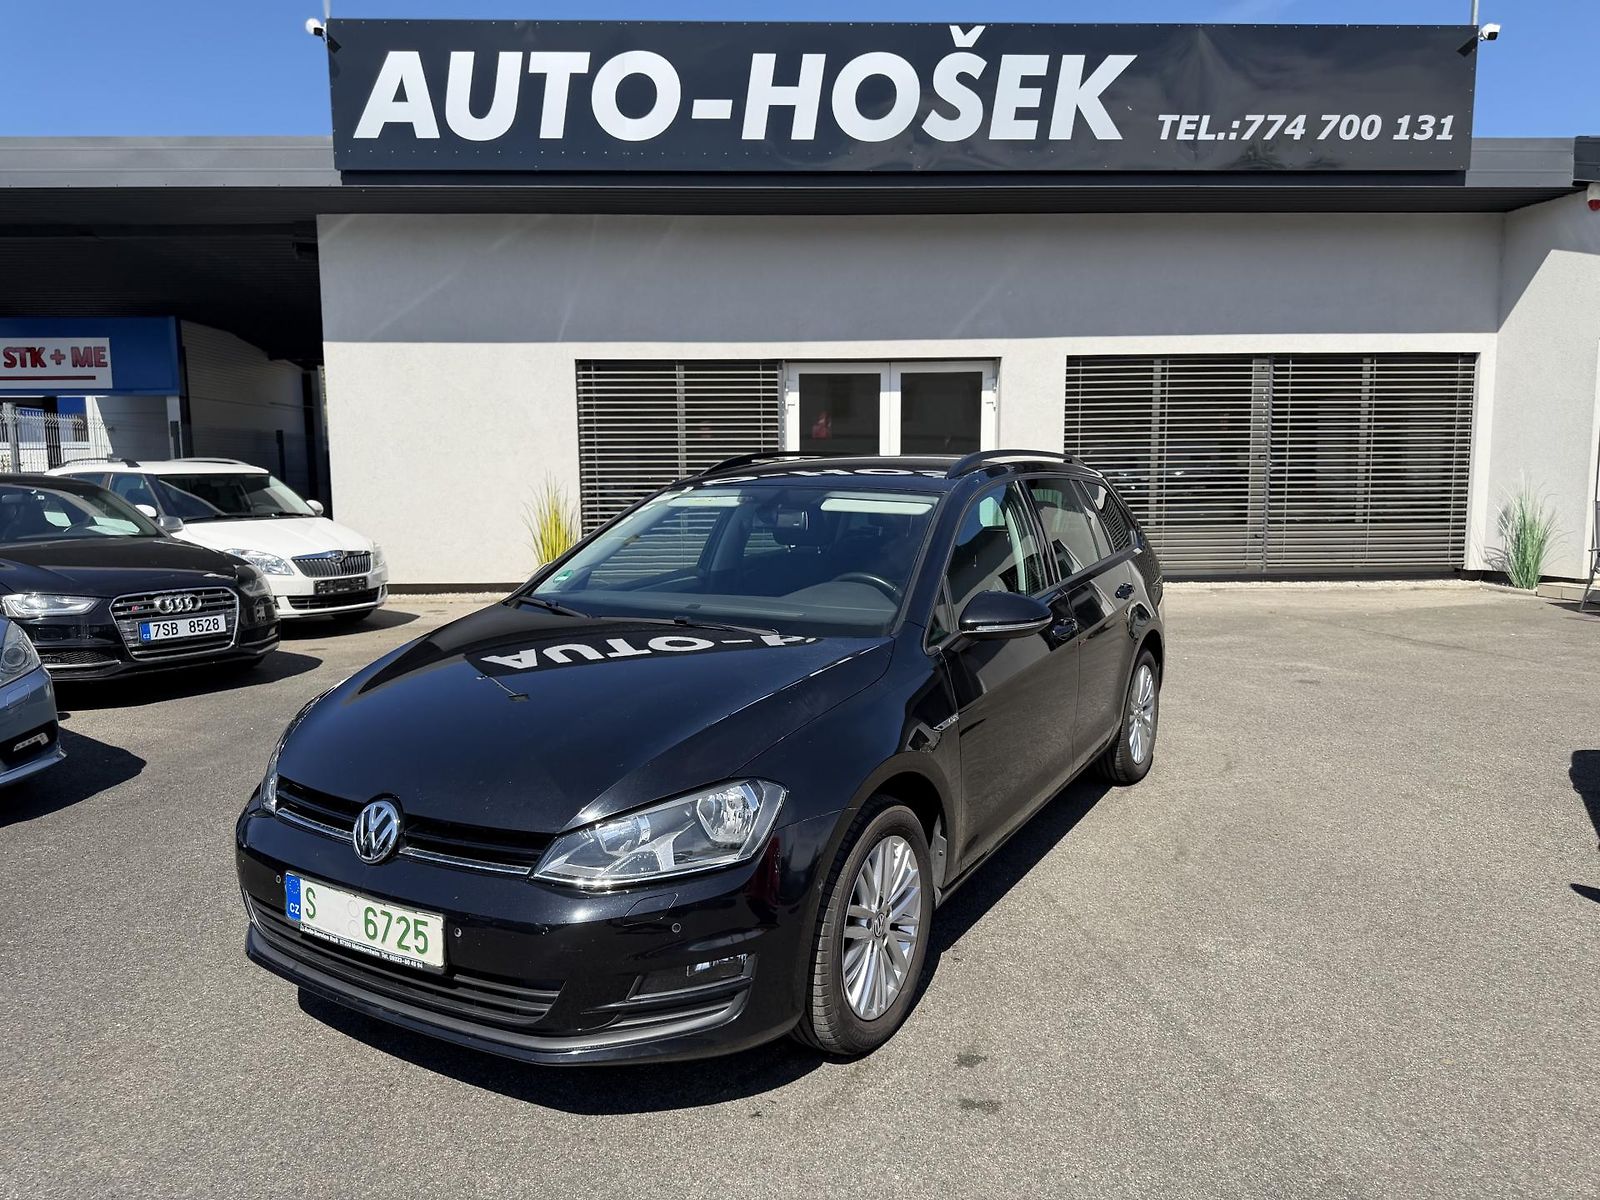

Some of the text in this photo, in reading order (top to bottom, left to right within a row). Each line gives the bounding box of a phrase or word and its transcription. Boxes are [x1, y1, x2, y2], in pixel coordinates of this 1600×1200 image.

[353, 25, 1137, 142] AUTO-HOŠEK
[1157, 114, 1454, 140] TEL.:774 700 131
[3, 346, 46, 368] STK
[70, 346, 107, 368] ME
[153, 618, 220, 638] 7SB 8528
[290, 903, 300, 915] CZ
[306, 886, 429, 955] S 6725
